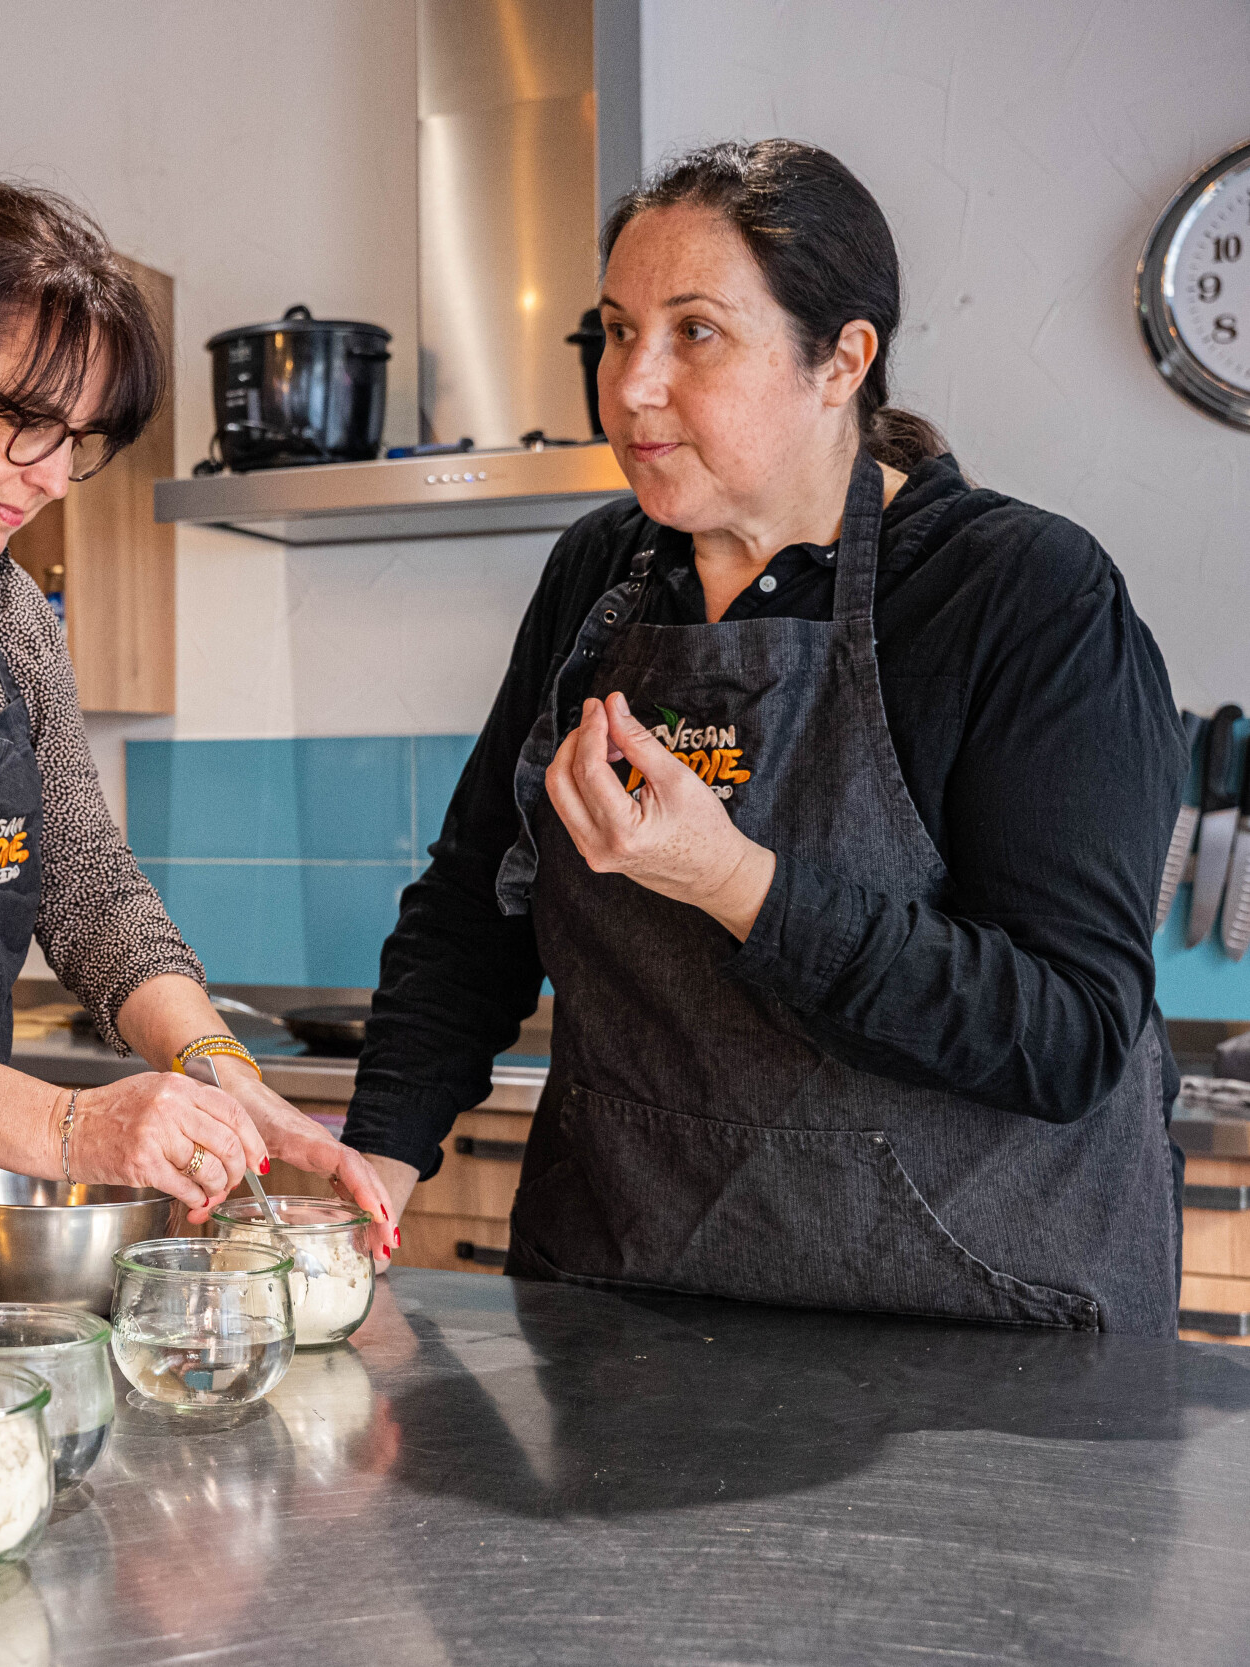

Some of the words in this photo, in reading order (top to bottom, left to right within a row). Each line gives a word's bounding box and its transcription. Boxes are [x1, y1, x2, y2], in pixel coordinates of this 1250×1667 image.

[1213, 234, 1243, 263] 10
[1197, 272, 1222, 304] 9
[1211, 313, 1238, 345] 8
[661, 717, 736, 751] VEGAN
